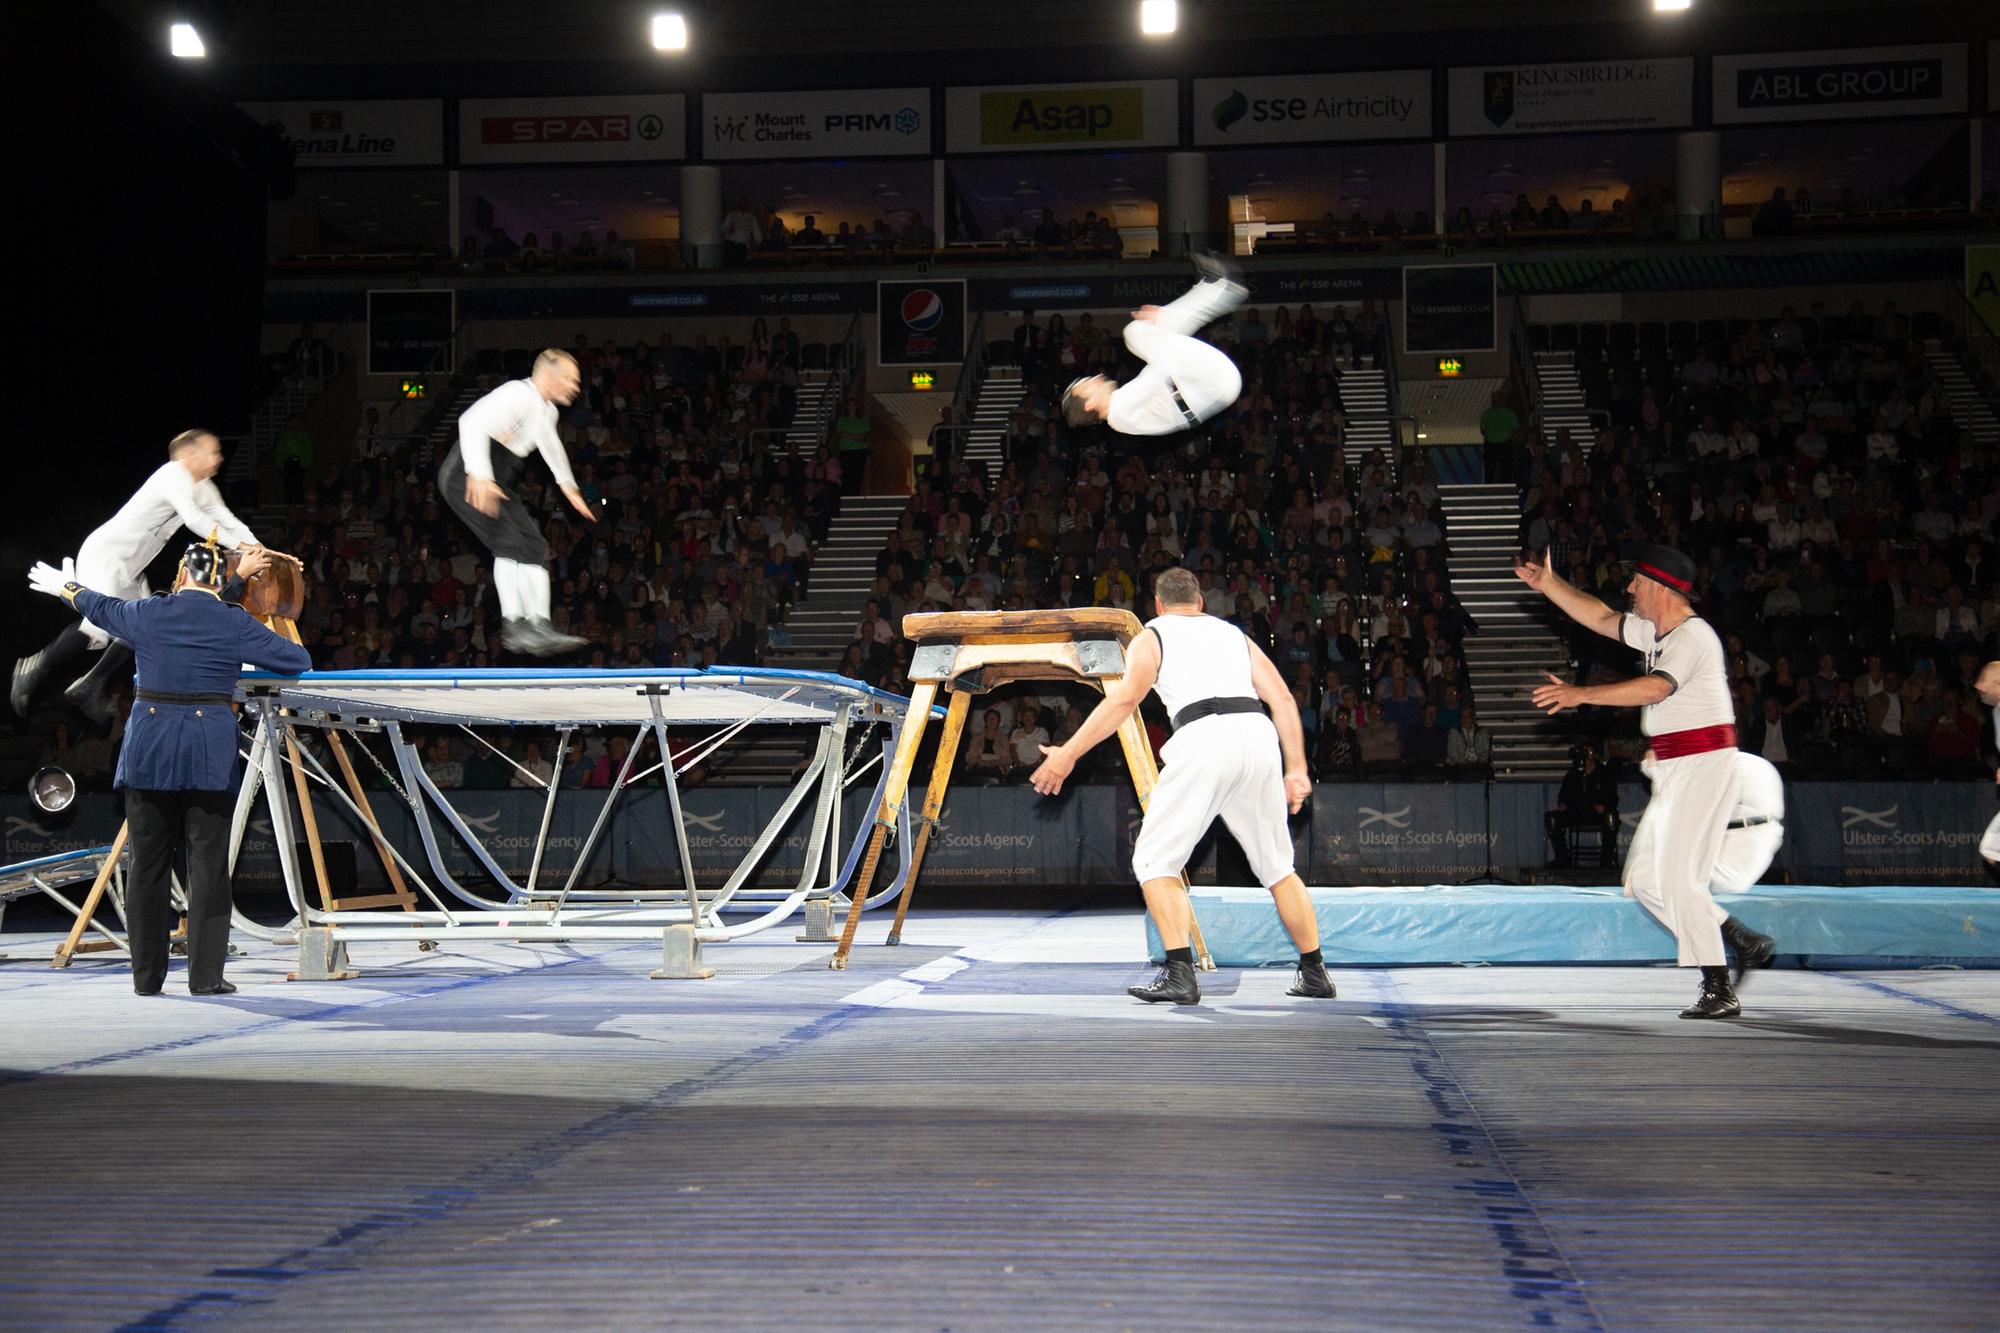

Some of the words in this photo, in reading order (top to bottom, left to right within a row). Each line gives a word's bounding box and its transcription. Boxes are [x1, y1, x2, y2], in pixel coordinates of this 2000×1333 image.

[1516, 64, 1657, 86] KINGSBRIDGE
[1750, 74, 1810, 101] ABL
[1815, 67, 1930, 97] GROUP
[1010, 96, 1114, 137] Asap
[1253, 97, 1307, 122] sse
[1312, 94, 1414, 121] Airtricity
[511, 117, 628, 141] SPAR
[755, 113, 807, 127] Mount
[825, 113, 891, 132] PRM
[342, 133, 396, 153] Line
[754, 128, 812, 142] Charles
[1279, 280, 1297, 290] THE
[1331, 279, 1363, 288] ARENA
[760, 294, 777, 303] THE
[810, 292, 841, 302] ARENA
[5, 838, 85, 854] Ulster-Scots
[984, 832, 1034, 849] Agency
[1359, 829, 1443, 846] Ulster-Scots
[1445, 829, 1498, 848] Agency
[1842, 829, 1934, 846] Ulster-Scots
[1843, 865, 1985, 877] www.ulsterscotsagency.co
